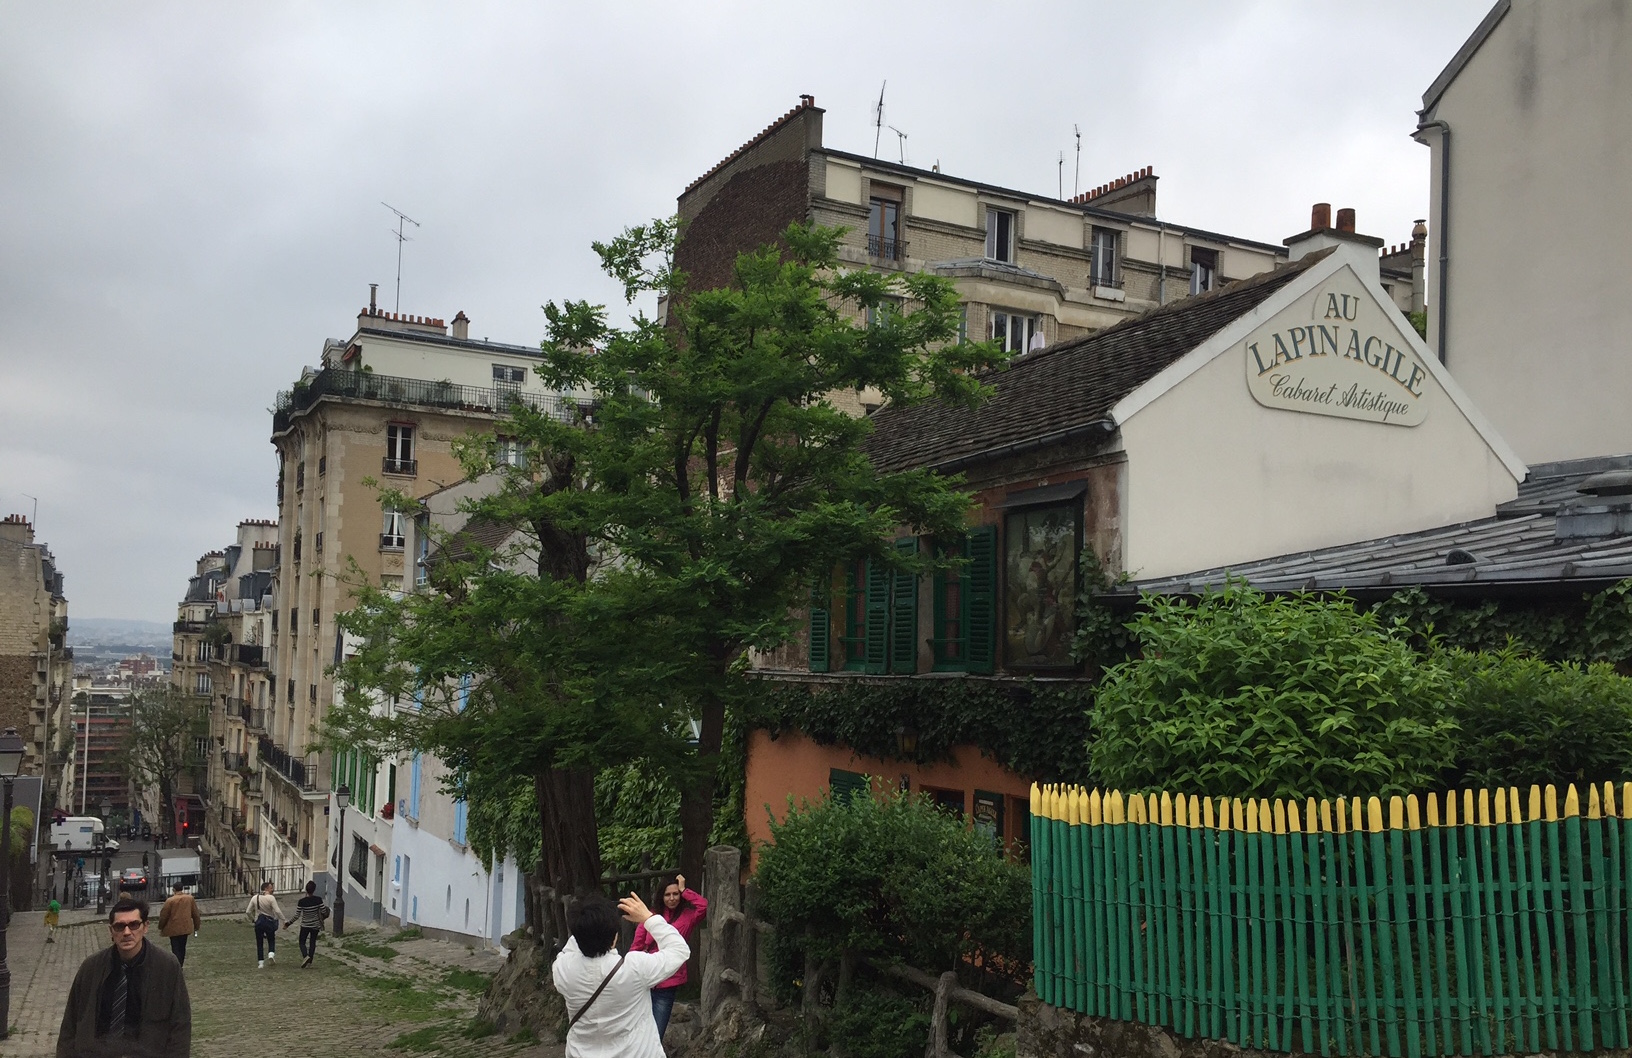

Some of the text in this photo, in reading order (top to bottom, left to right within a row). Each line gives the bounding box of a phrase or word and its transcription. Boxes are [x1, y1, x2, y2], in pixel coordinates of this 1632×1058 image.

[1324, 293, 1360, 321] AU
[1248, 324, 1426, 399] LAPIN AGILE
[1269, 373, 1409, 421] Cabaret Artistique
